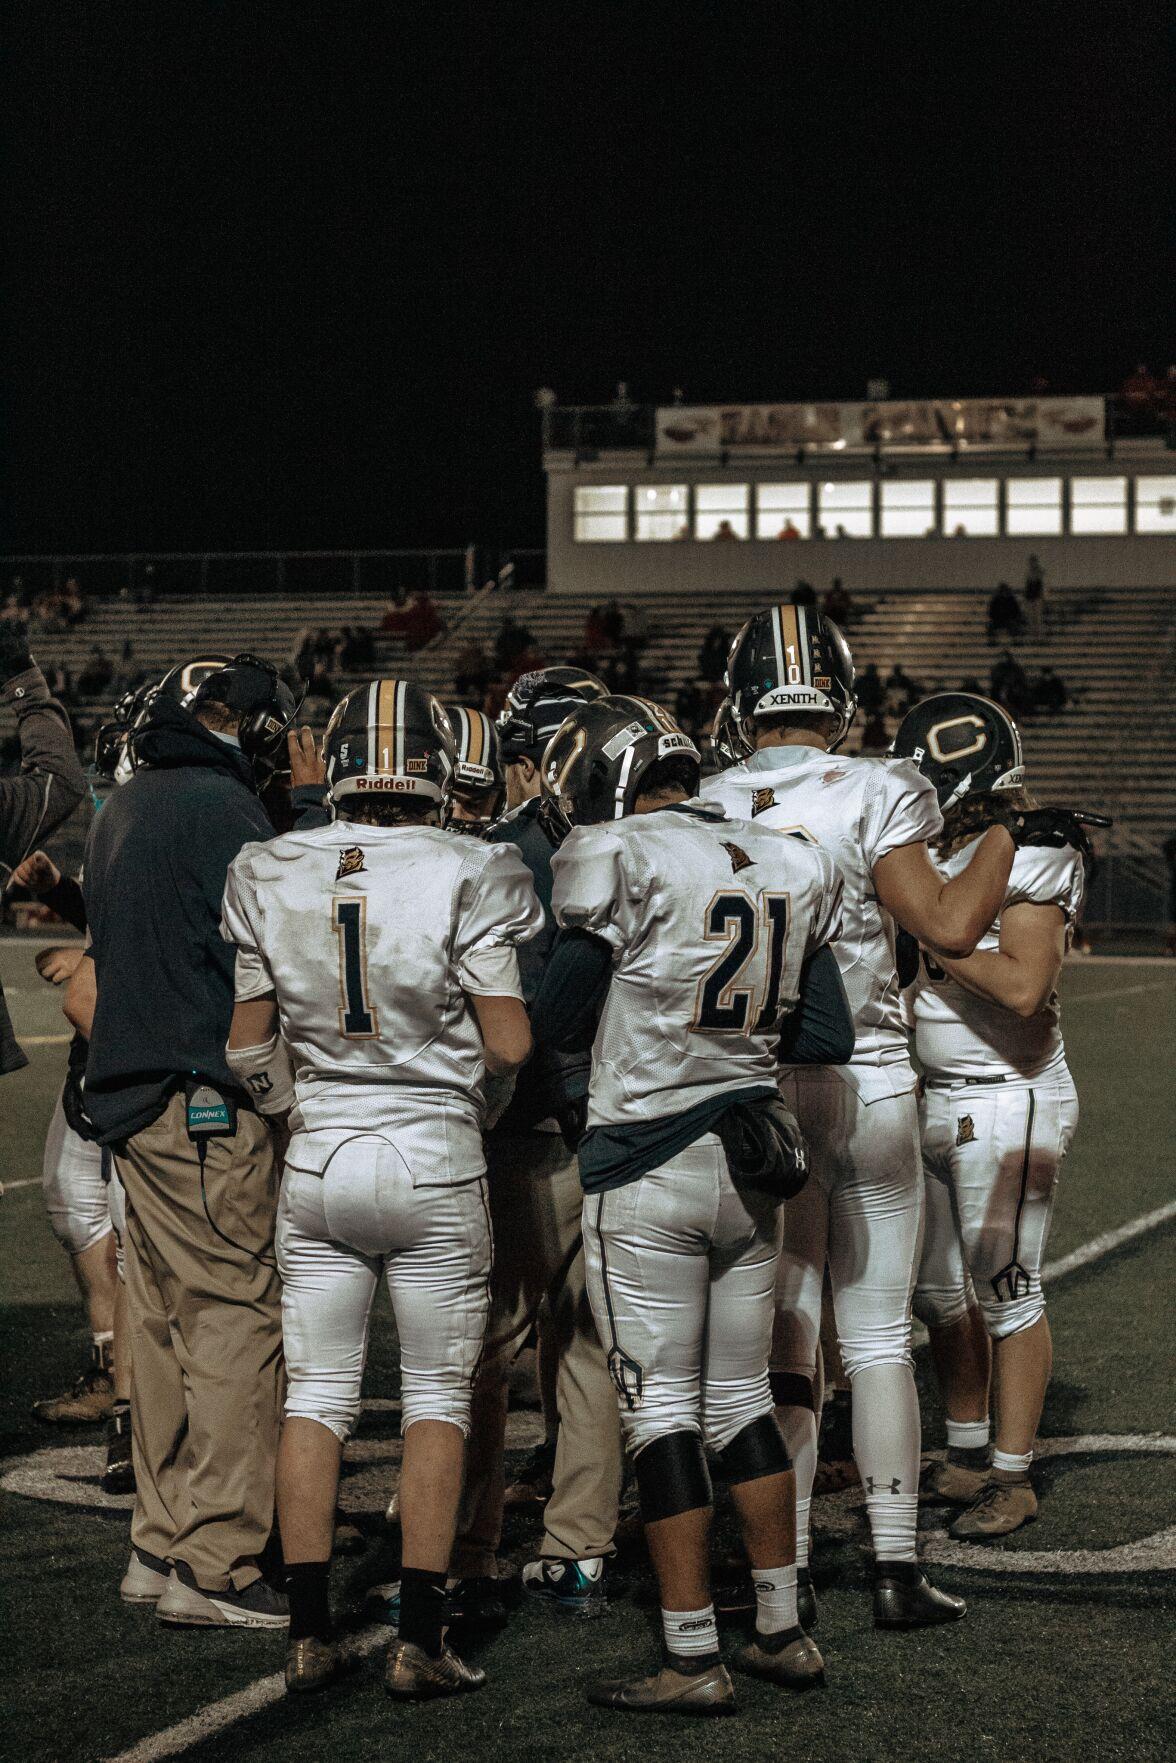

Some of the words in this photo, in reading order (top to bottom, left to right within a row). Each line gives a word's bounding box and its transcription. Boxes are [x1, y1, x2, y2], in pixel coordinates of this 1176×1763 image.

[770, 693, 818, 706] XENITH
[382, 747, 389, 769] 1
[356, 778, 416, 791] Riddell
[332, 896, 380, 1040] 1
[688, 888, 791, 1036] 21
[190, 1110, 226, 1119] CONNEX
